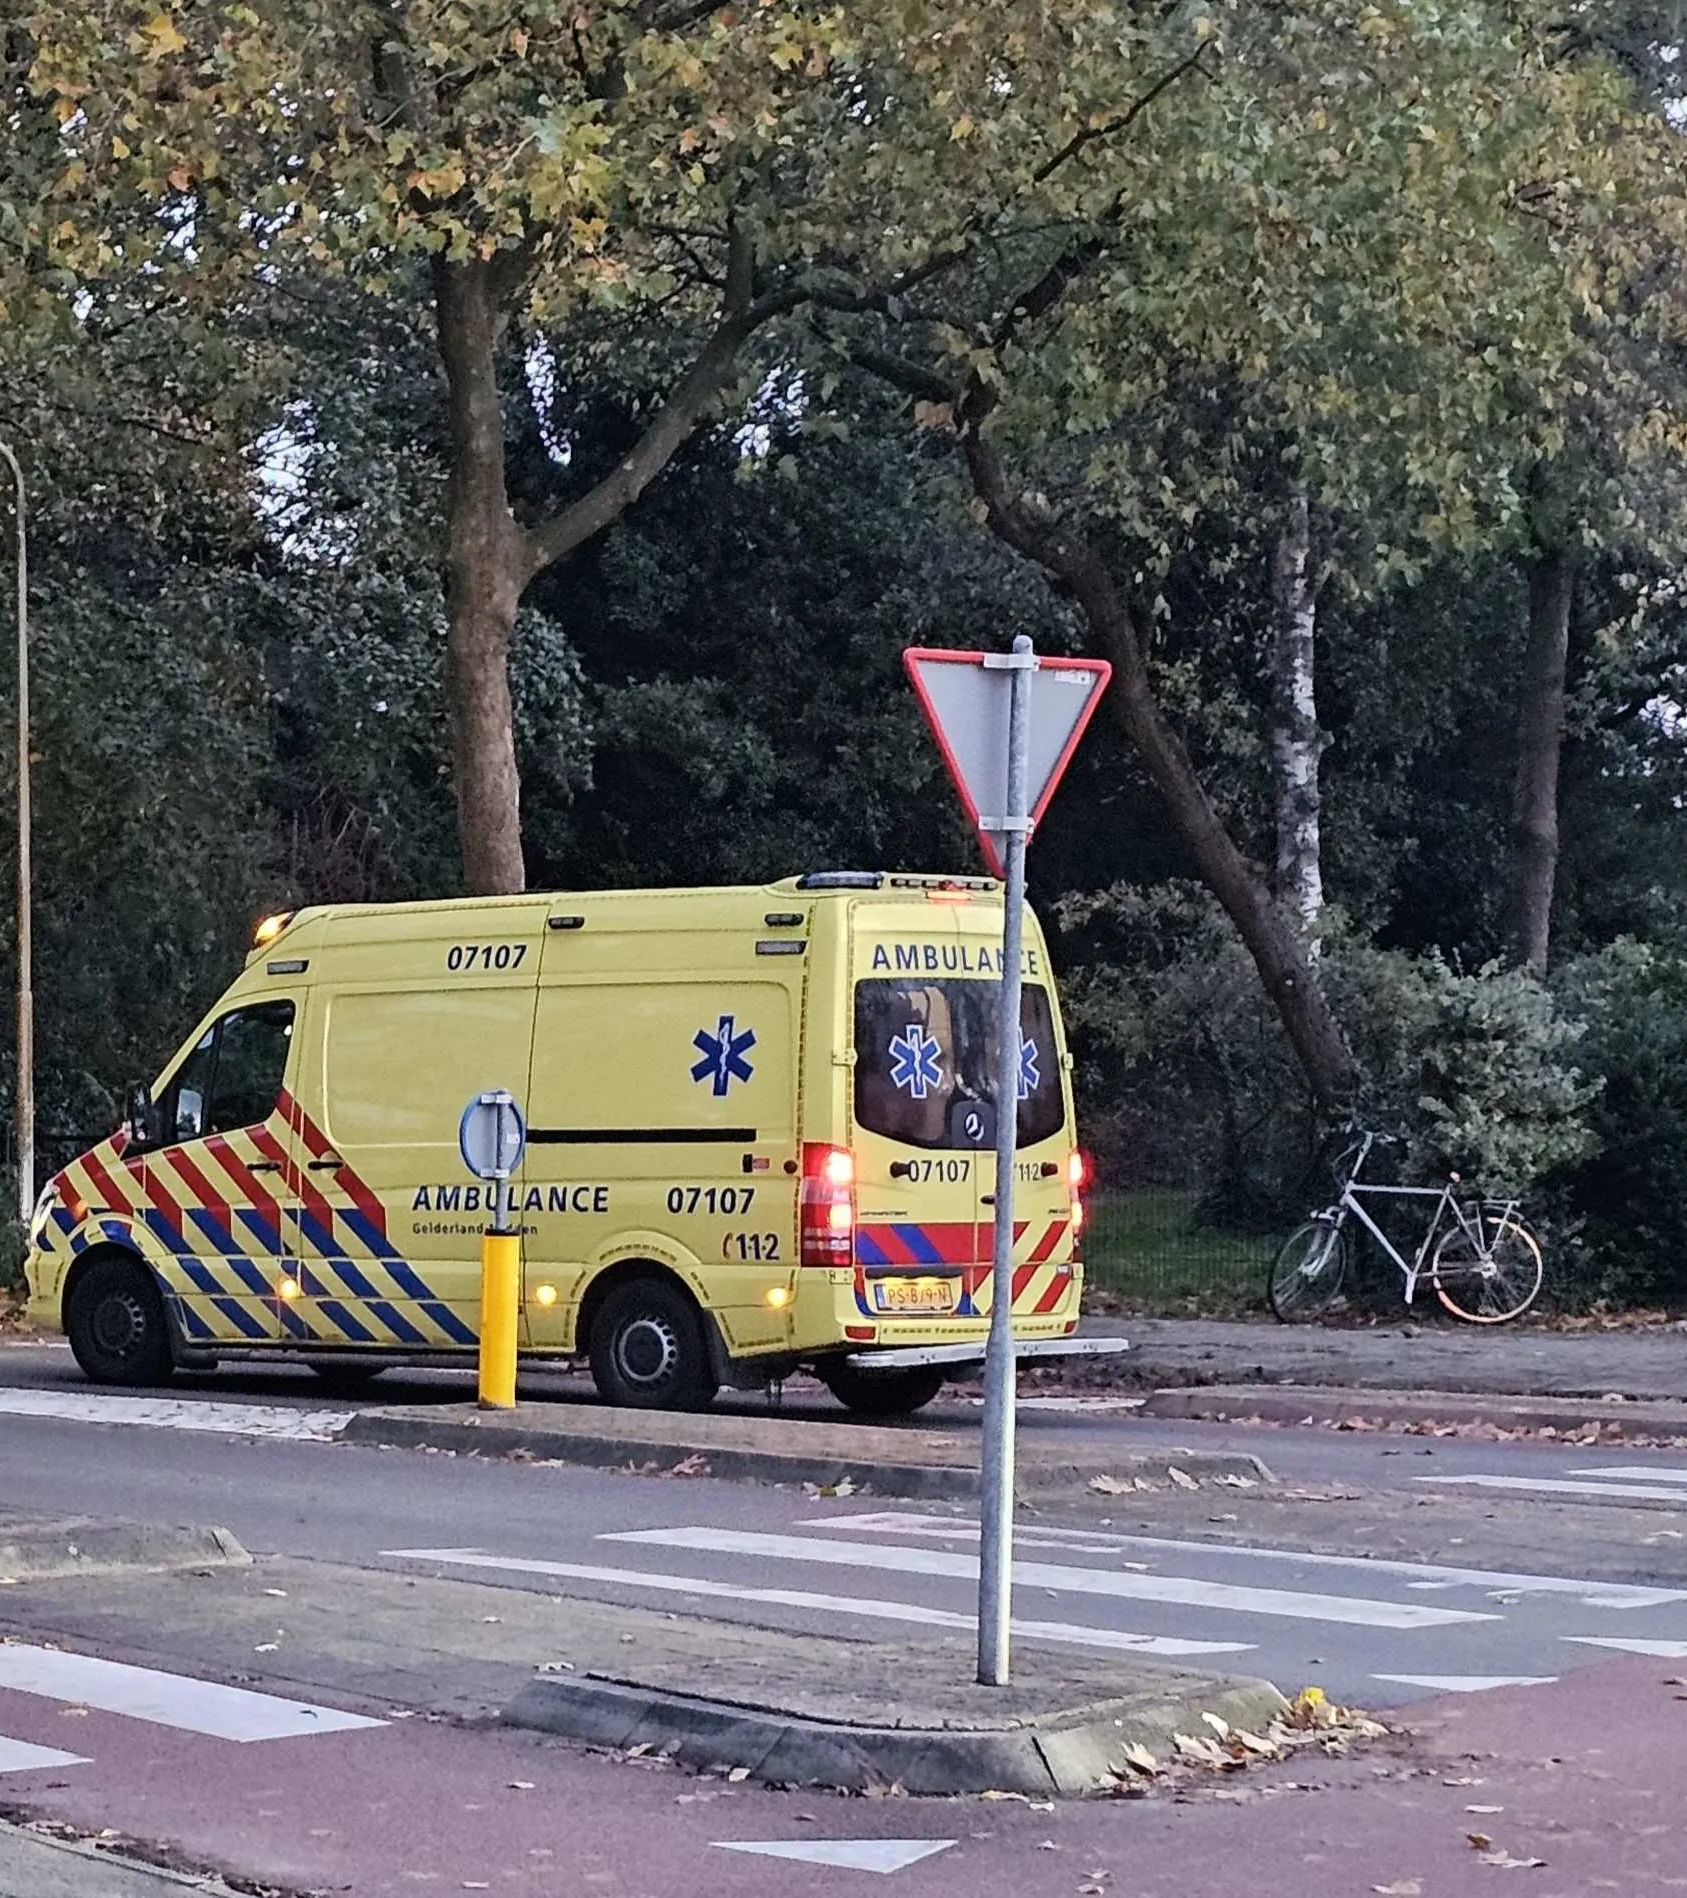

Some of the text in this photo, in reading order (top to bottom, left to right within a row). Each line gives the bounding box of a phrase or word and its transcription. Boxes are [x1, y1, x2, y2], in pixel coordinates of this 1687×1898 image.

[447, 944, 528, 971] 07107
[909, 1159, 971, 1183] 07107
[412, 1184, 610, 1213] AMBULANCE
[667, 1186, 756, 1214] 07107
